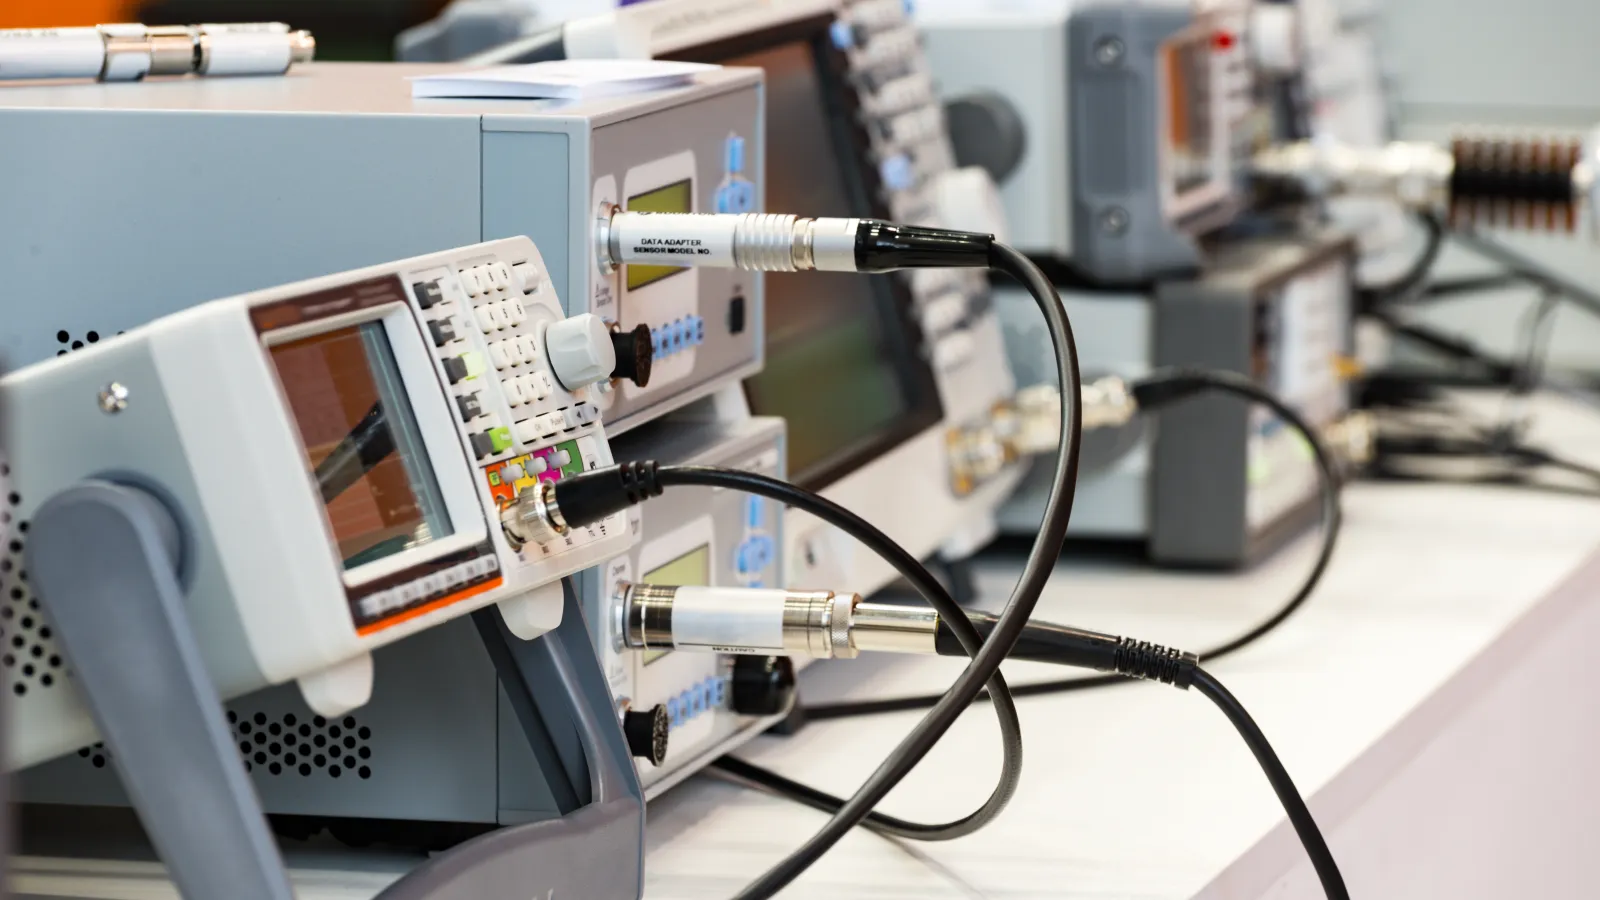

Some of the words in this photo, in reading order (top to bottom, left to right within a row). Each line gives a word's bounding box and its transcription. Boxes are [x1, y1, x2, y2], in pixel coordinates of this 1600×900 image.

[633, 246, 666, 254] SENSOR
[667, 247, 697, 255] MODEL
[697, 248, 713, 256] NO.
